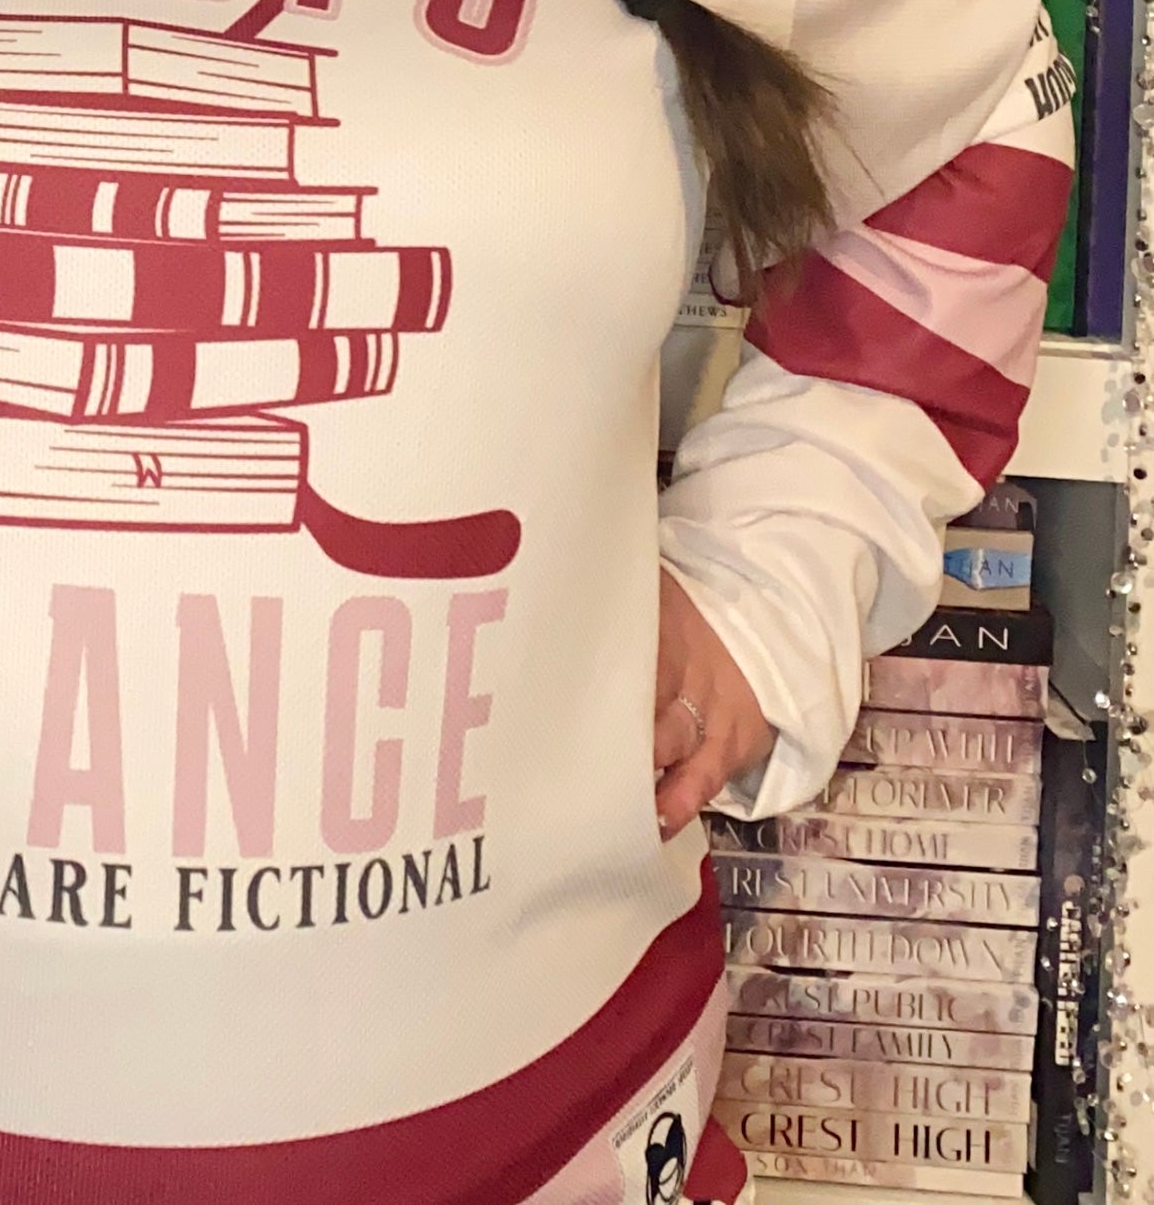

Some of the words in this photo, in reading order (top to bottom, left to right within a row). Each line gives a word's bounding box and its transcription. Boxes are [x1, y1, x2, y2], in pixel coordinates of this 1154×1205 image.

[175, 837, 491, 931] FICTIONAL
[887, 937, 1003, 970] DOWN
[852, 989, 958, 1021] PUBLIC
[852, 1028, 955, 1059] FAMILY
[740, 1069, 856, 1103] CREST
[894, 1077, 990, 1115] HIGH
[741, 1113, 857, 1151] CREST
[894, 1124, 990, 1162] HIGH
